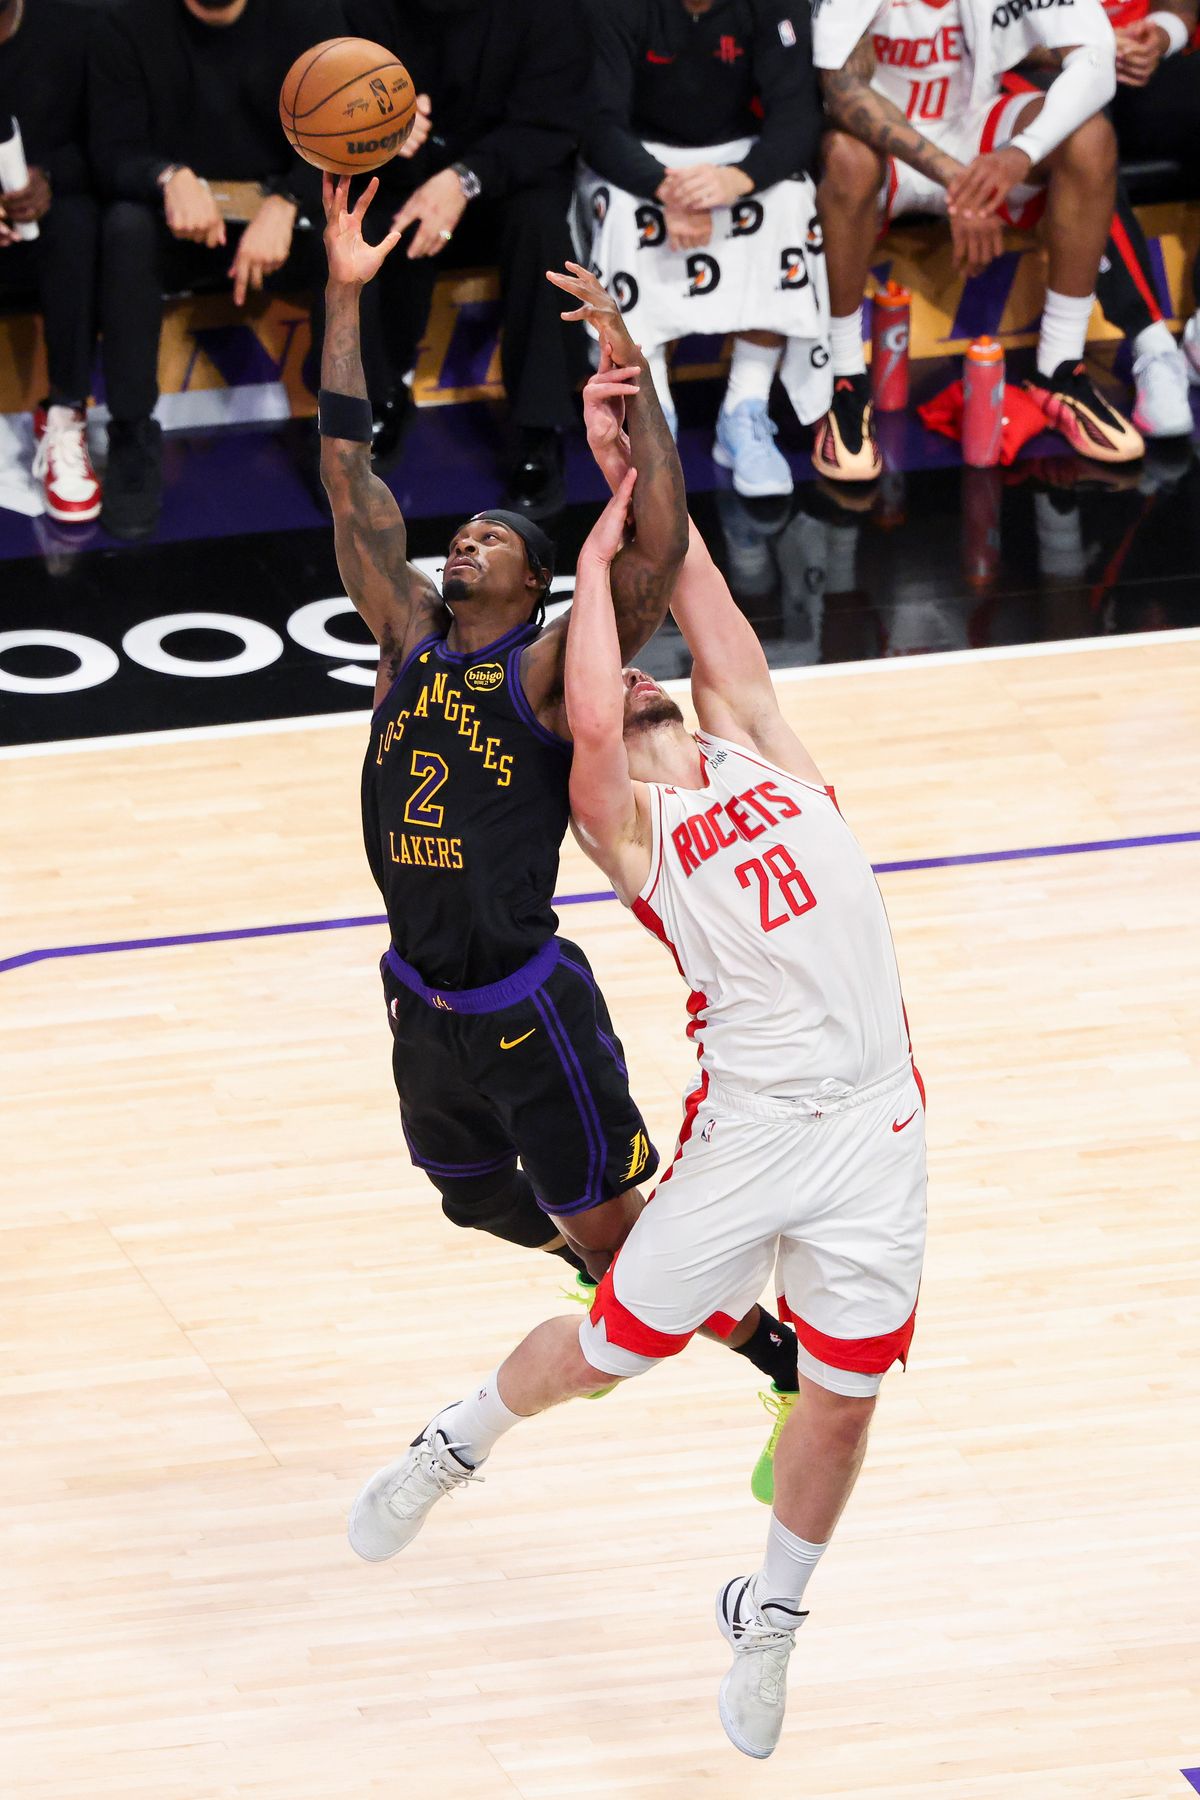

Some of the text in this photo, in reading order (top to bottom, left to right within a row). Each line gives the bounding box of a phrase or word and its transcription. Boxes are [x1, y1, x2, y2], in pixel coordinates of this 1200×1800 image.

[906, 77, 949, 120] 10
[810, 345, 829, 368] G
[469, 670, 502, 684] bibigo
[376, 672, 514, 787] LOS ANGELES
[403, 750, 449, 828] 2
[389, 831, 463, 869] LAKERS
[671, 781, 802, 879] ROCETS
[734, 844, 817, 933] 28
